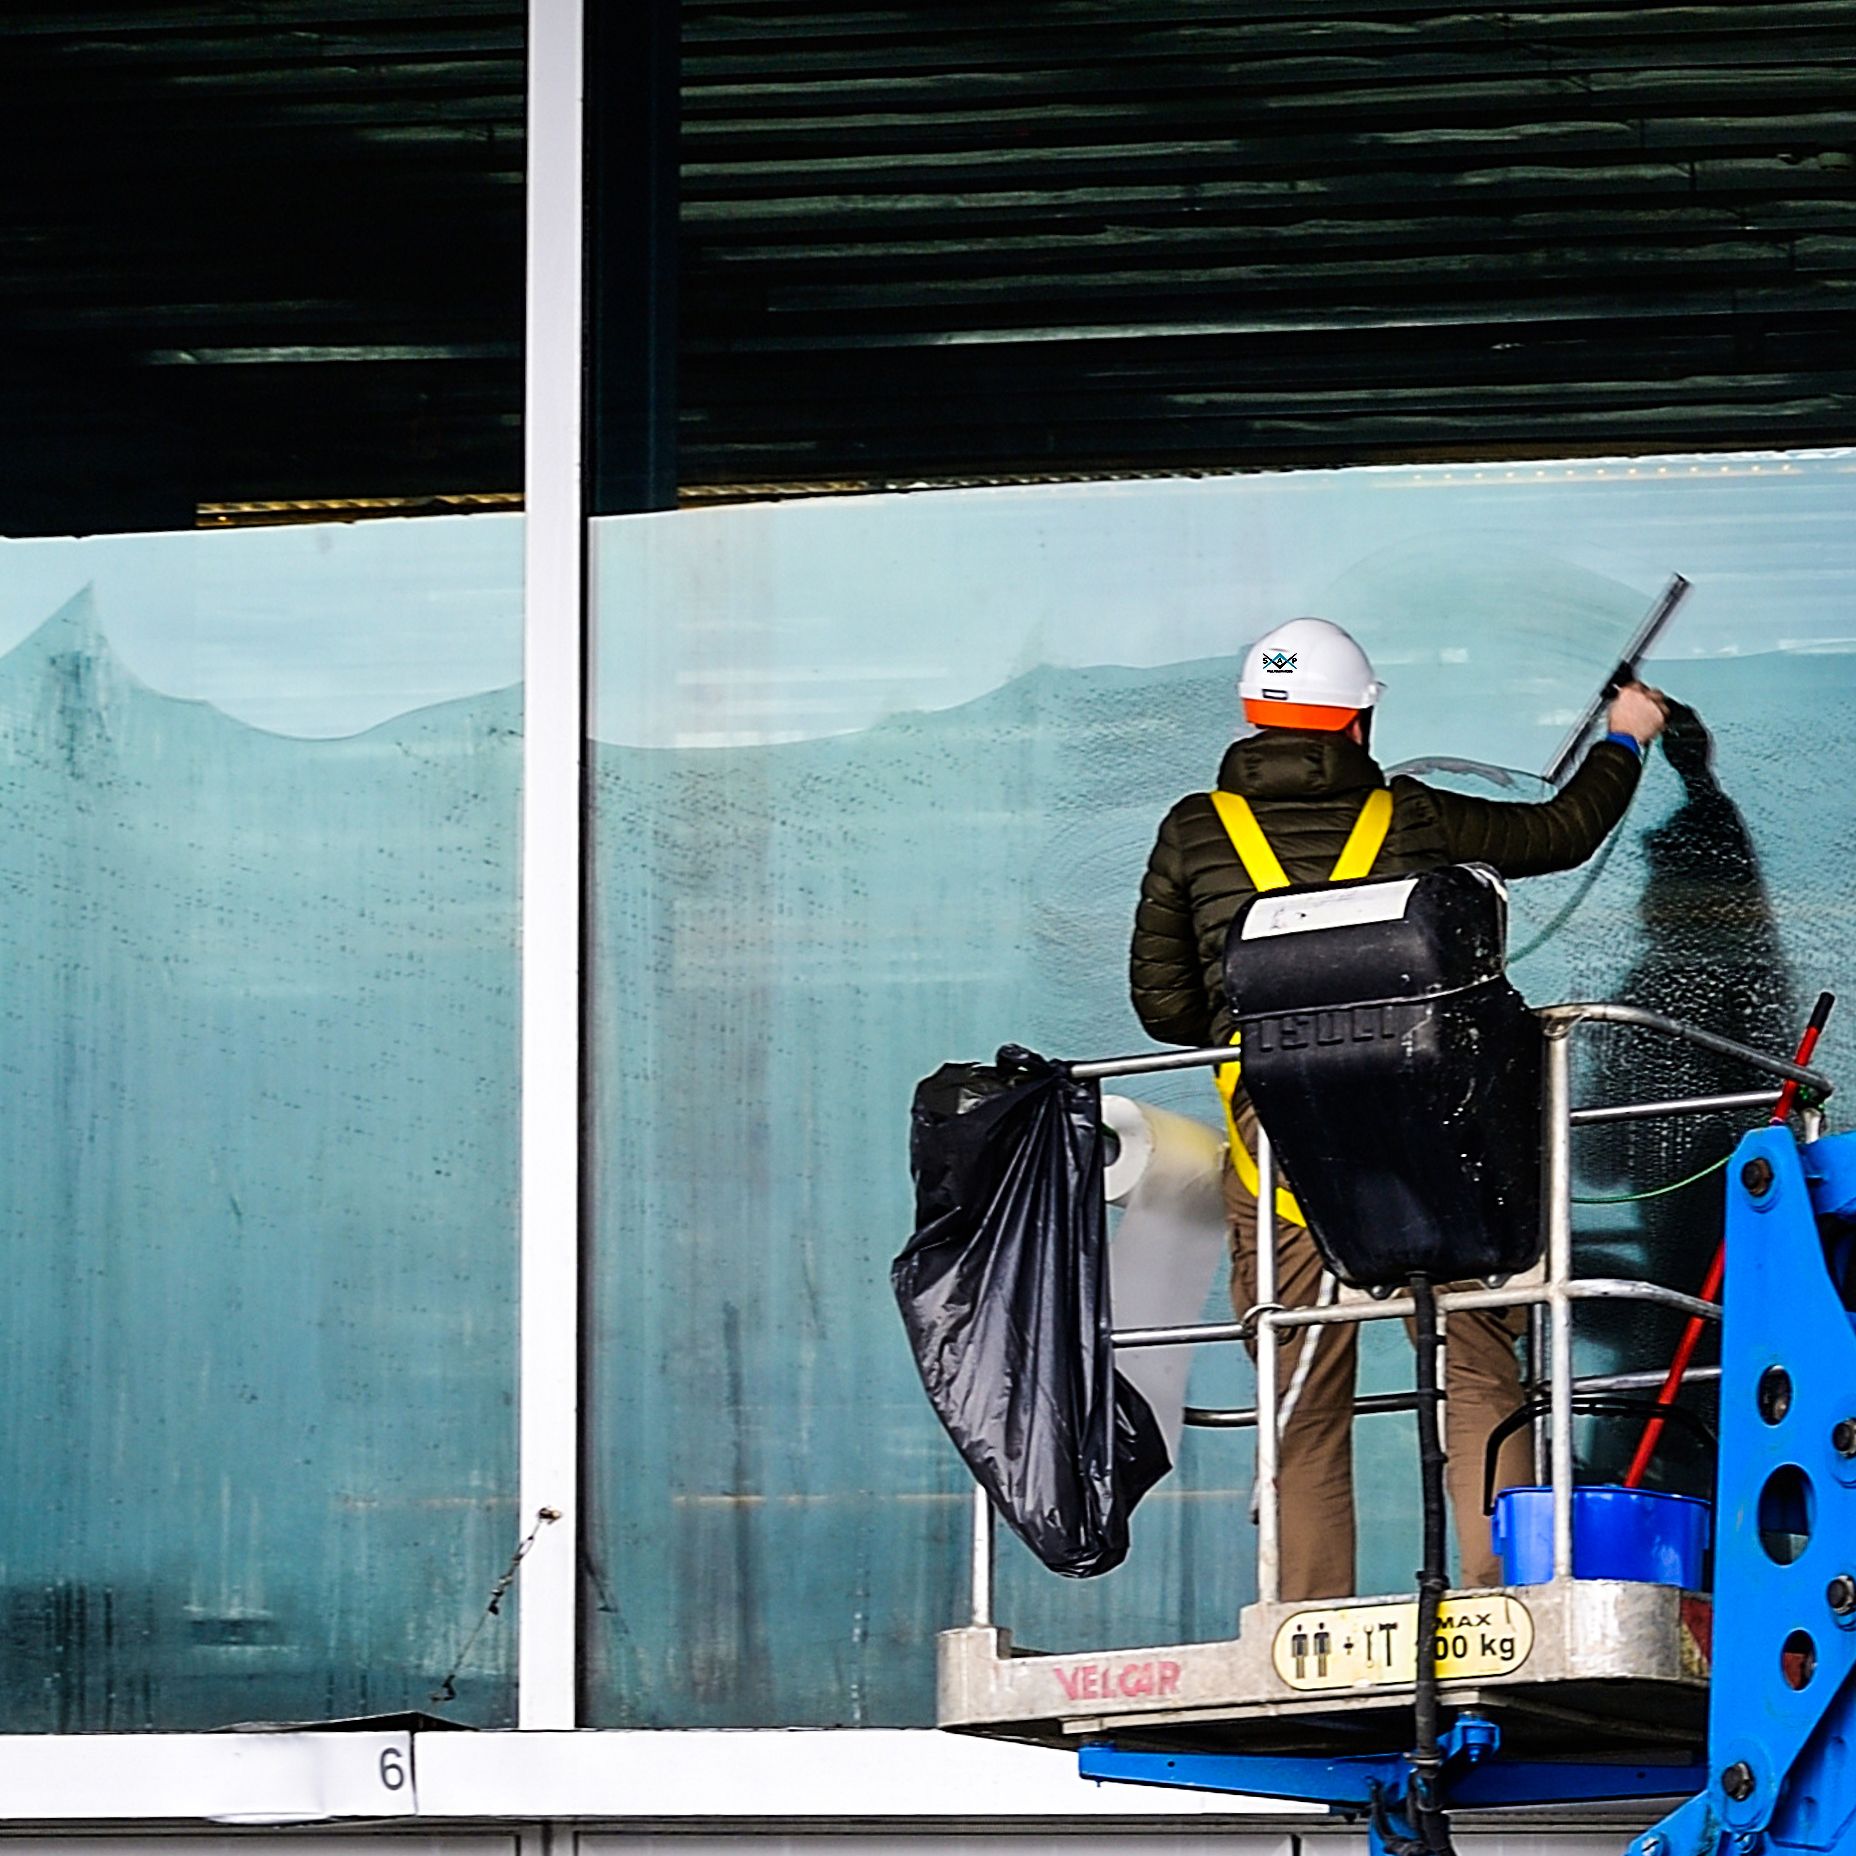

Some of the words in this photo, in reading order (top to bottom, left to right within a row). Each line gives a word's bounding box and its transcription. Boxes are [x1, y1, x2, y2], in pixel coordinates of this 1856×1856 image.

[1435, 1613, 1491, 1629] MAX
[1418, 1635, 1467, 1660] 00
[1481, 1634, 1515, 1661] kg
[1053, 1661, 1181, 1700] VELCAR
[380, 1747, 404, 1791] 6
